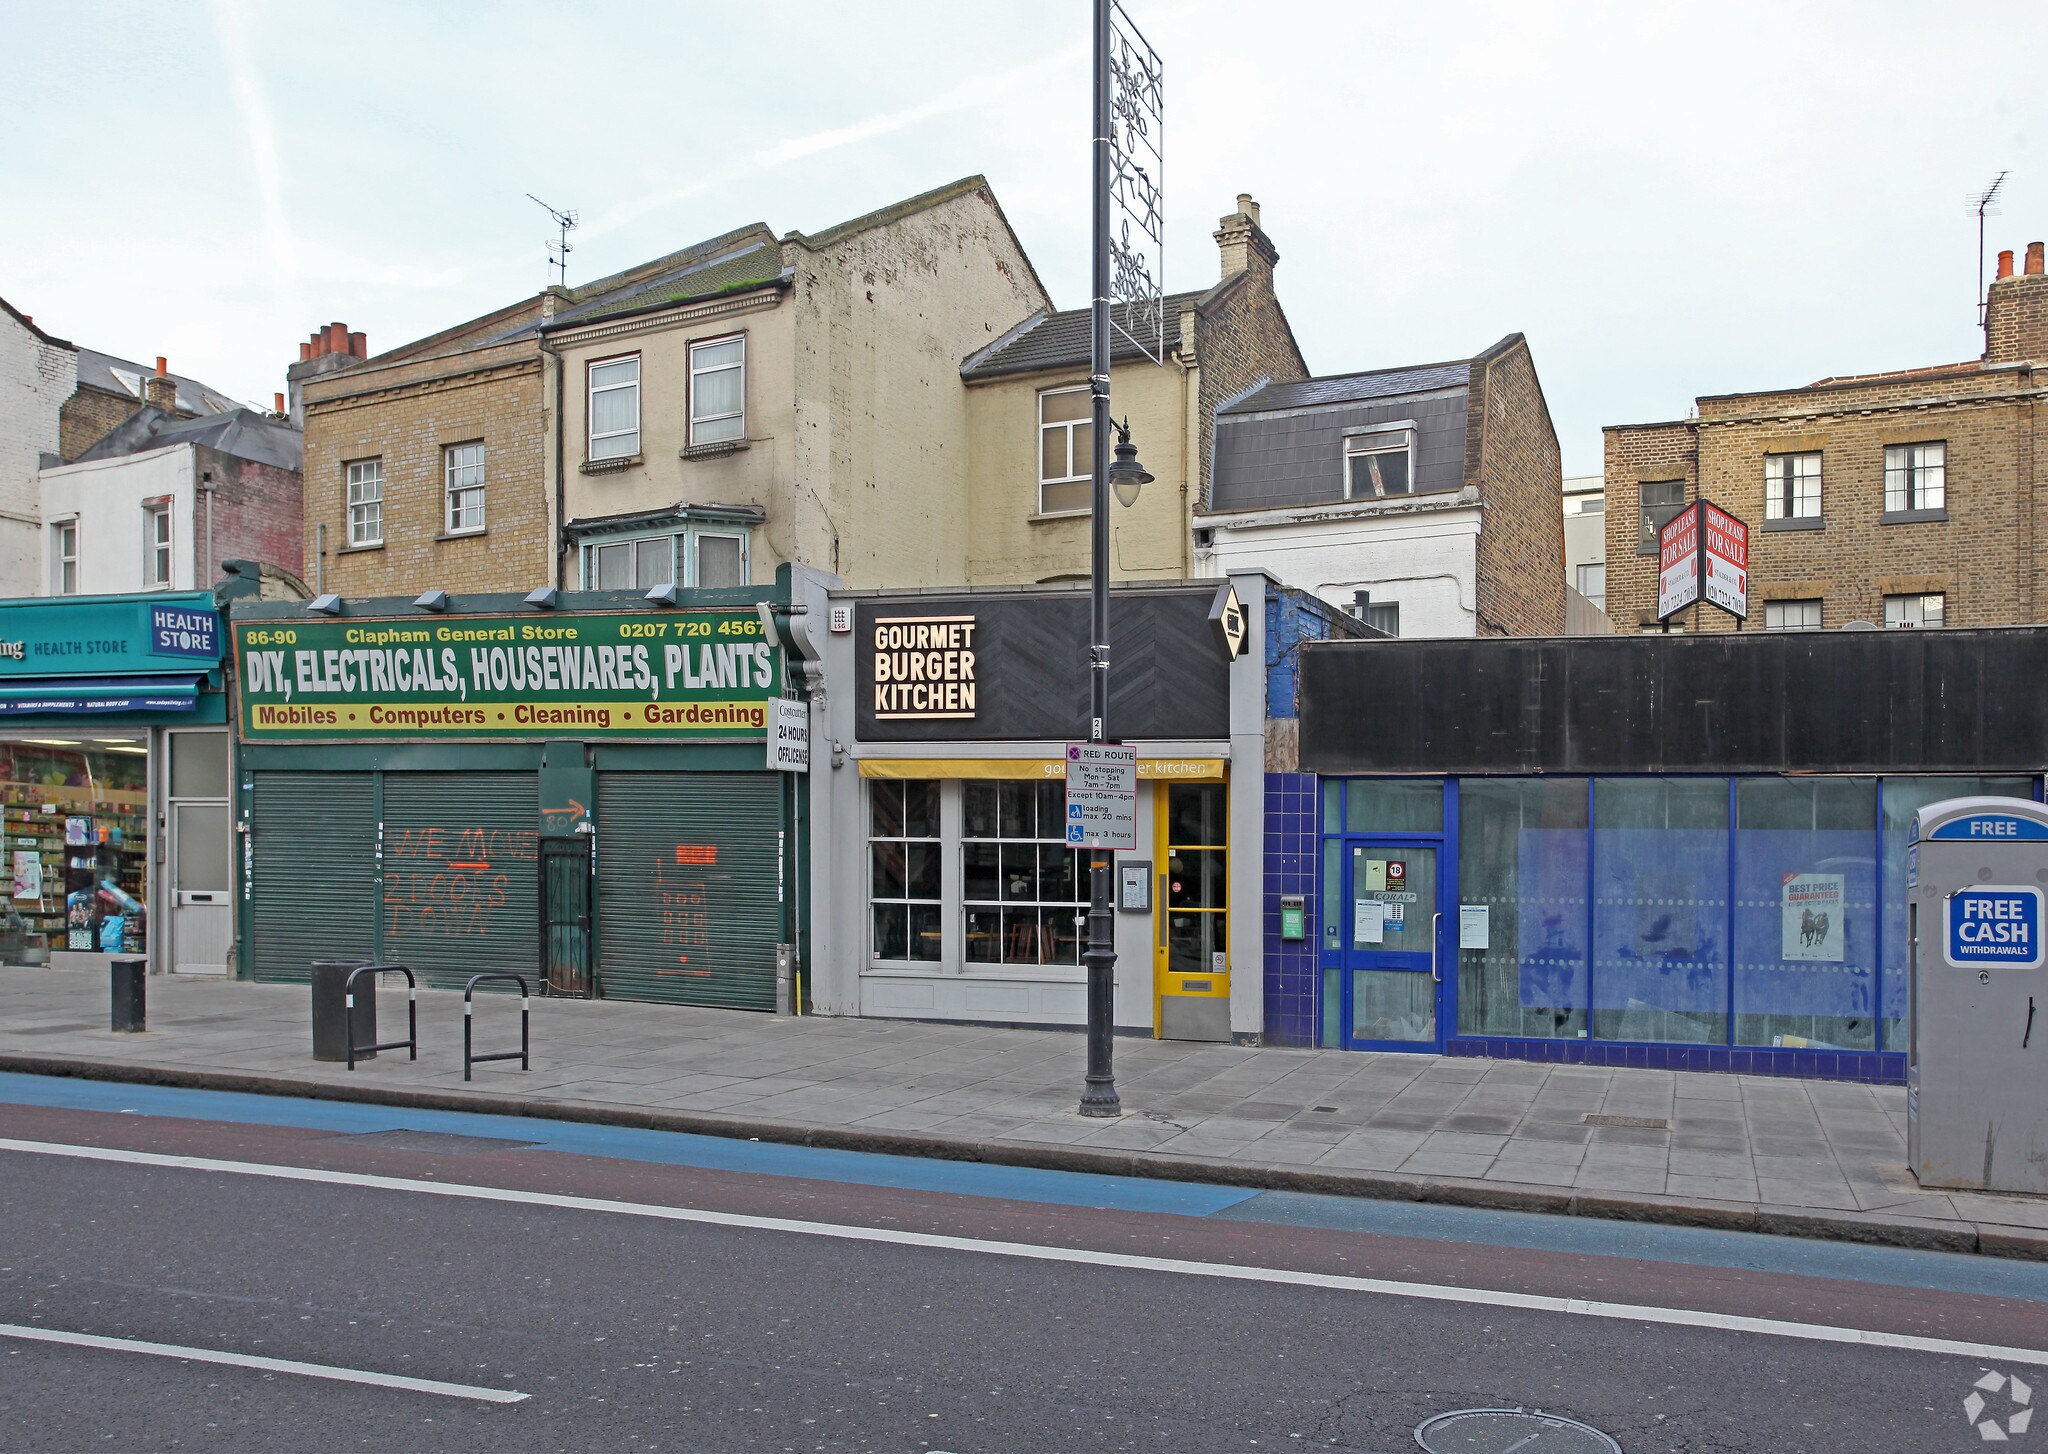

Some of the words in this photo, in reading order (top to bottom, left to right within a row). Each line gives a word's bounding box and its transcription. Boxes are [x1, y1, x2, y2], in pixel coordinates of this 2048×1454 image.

[1664, 524, 1678, 544] SHOP
[1678, 508, 1695, 534] LEASE
[1707, 508, 1723, 527] SHOP
[1723, 519, 1744, 542] LEASE
[1662, 544, 1678, 567] FOR
[1678, 528, 1697, 556] SALE
[1707, 528, 1724, 556] FOR
[1724, 538, 1744, 565] SALE
[155, 611, 213, 633] HEALTH
[160, 631, 211, 650] STORE
[246, 630, 297, 645] 86-90
[346, 628, 430, 646] Clapham
[436, 626, 515, 642] General
[521, 625, 578, 640] Store
[619, 623, 668, 638] 0207
[674, 622, 711, 637] 720
[718, 620, 765, 636] 4567
[875, 623, 976, 650] GOURMET
[34, 641, 82, 656] HEALTH
[87, 640, 128, 654] STORE
[246, 650, 292, 702] DIY,
[295, 647, 466, 702] ELECTRICALS,
[471, 644, 659, 701] HOUSEWARES,
[664, 642, 773, 689] PLANTS
[875, 651, 976, 681] BURGER
[875, 682, 976, 711] KITCHEN
[259, 706, 337, 724] Mobiles
[370, 705, 486, 728] Computers
[514, 704, 610, 728] Cleaning
[644, 703, 764, 728] Gardening
[779, 704, 807, 719] Costcutter
[778, 724, 787, 739] 24
[788, 725, 807, 742] HOURS
[1083, 750, 1101, 759] RED
[1104, 751, 1134, 760] ROUTE
[1095, 766, 1125, 775] stopping
[1155, 761, 1206, 774] kitchen
[1067, 791, 1093, 799] Except
[1083, 805, 1109, 813] loading
[1103, 830, 1109, 838] 3
[1970, 821, 2017, 836] FREE
[1391, 866, 1401, 874] 18
[1788, 884, 1811, 893] BEST
[1812, 882, 1839, 892] PRICE
[1788, 891, 1839, 901] GUARANTEED
[1375, 893, 1410, 901] CORAL
[1963, 899, 2023, 920] FREE
[1958, 922, 2028, 943] CASH
[1960, 945, 2028, 955] WITHDRAWALS
